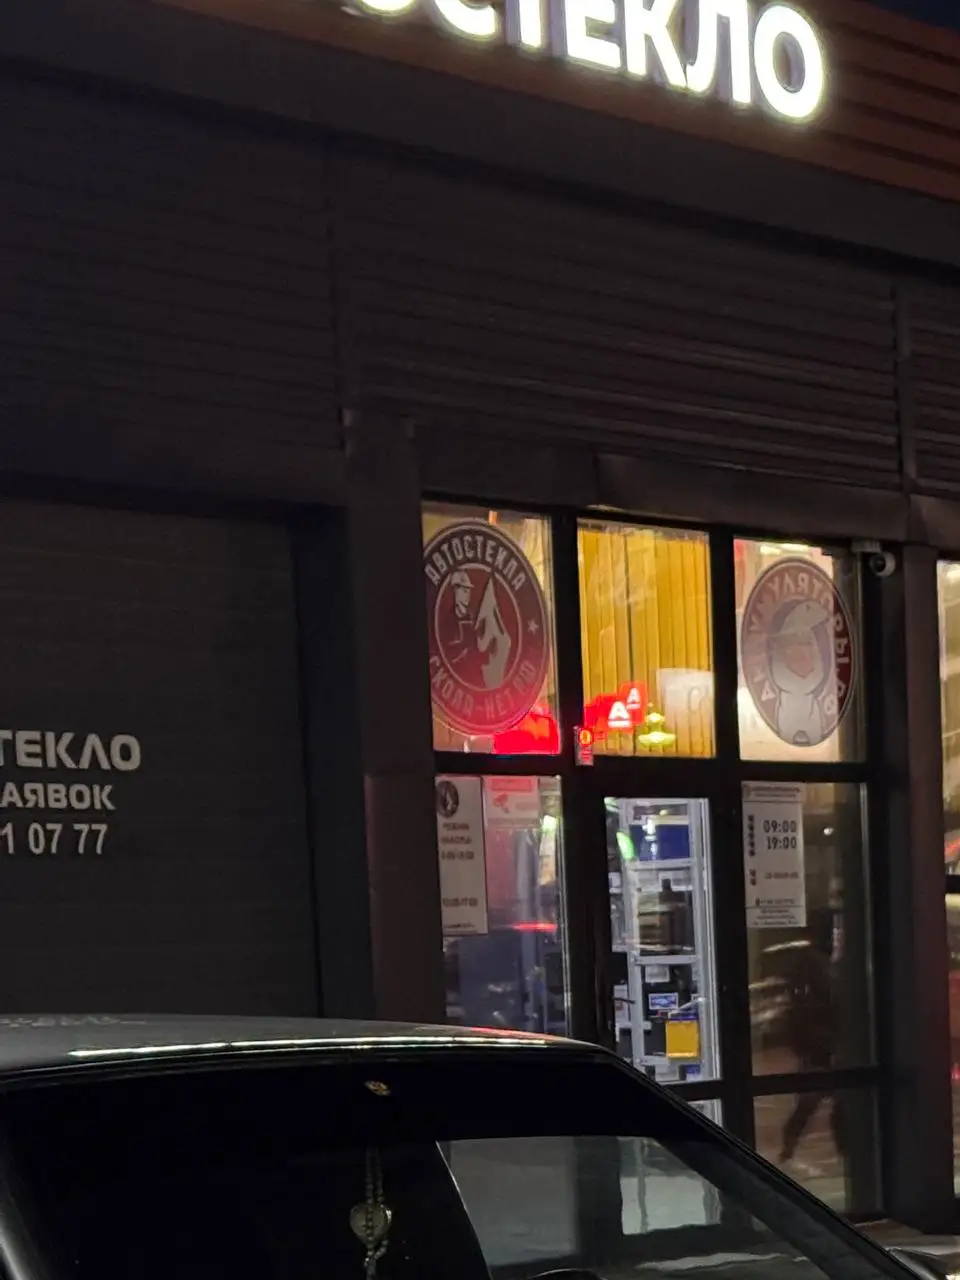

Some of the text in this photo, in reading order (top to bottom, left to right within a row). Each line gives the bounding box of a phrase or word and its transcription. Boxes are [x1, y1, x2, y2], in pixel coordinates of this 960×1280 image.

[762, 819, 798, 834] 09:00
[28, 822, 63, 855] 07
[73, 822, 108, 855] 77
[766, 835, 798, 850] 19:00
